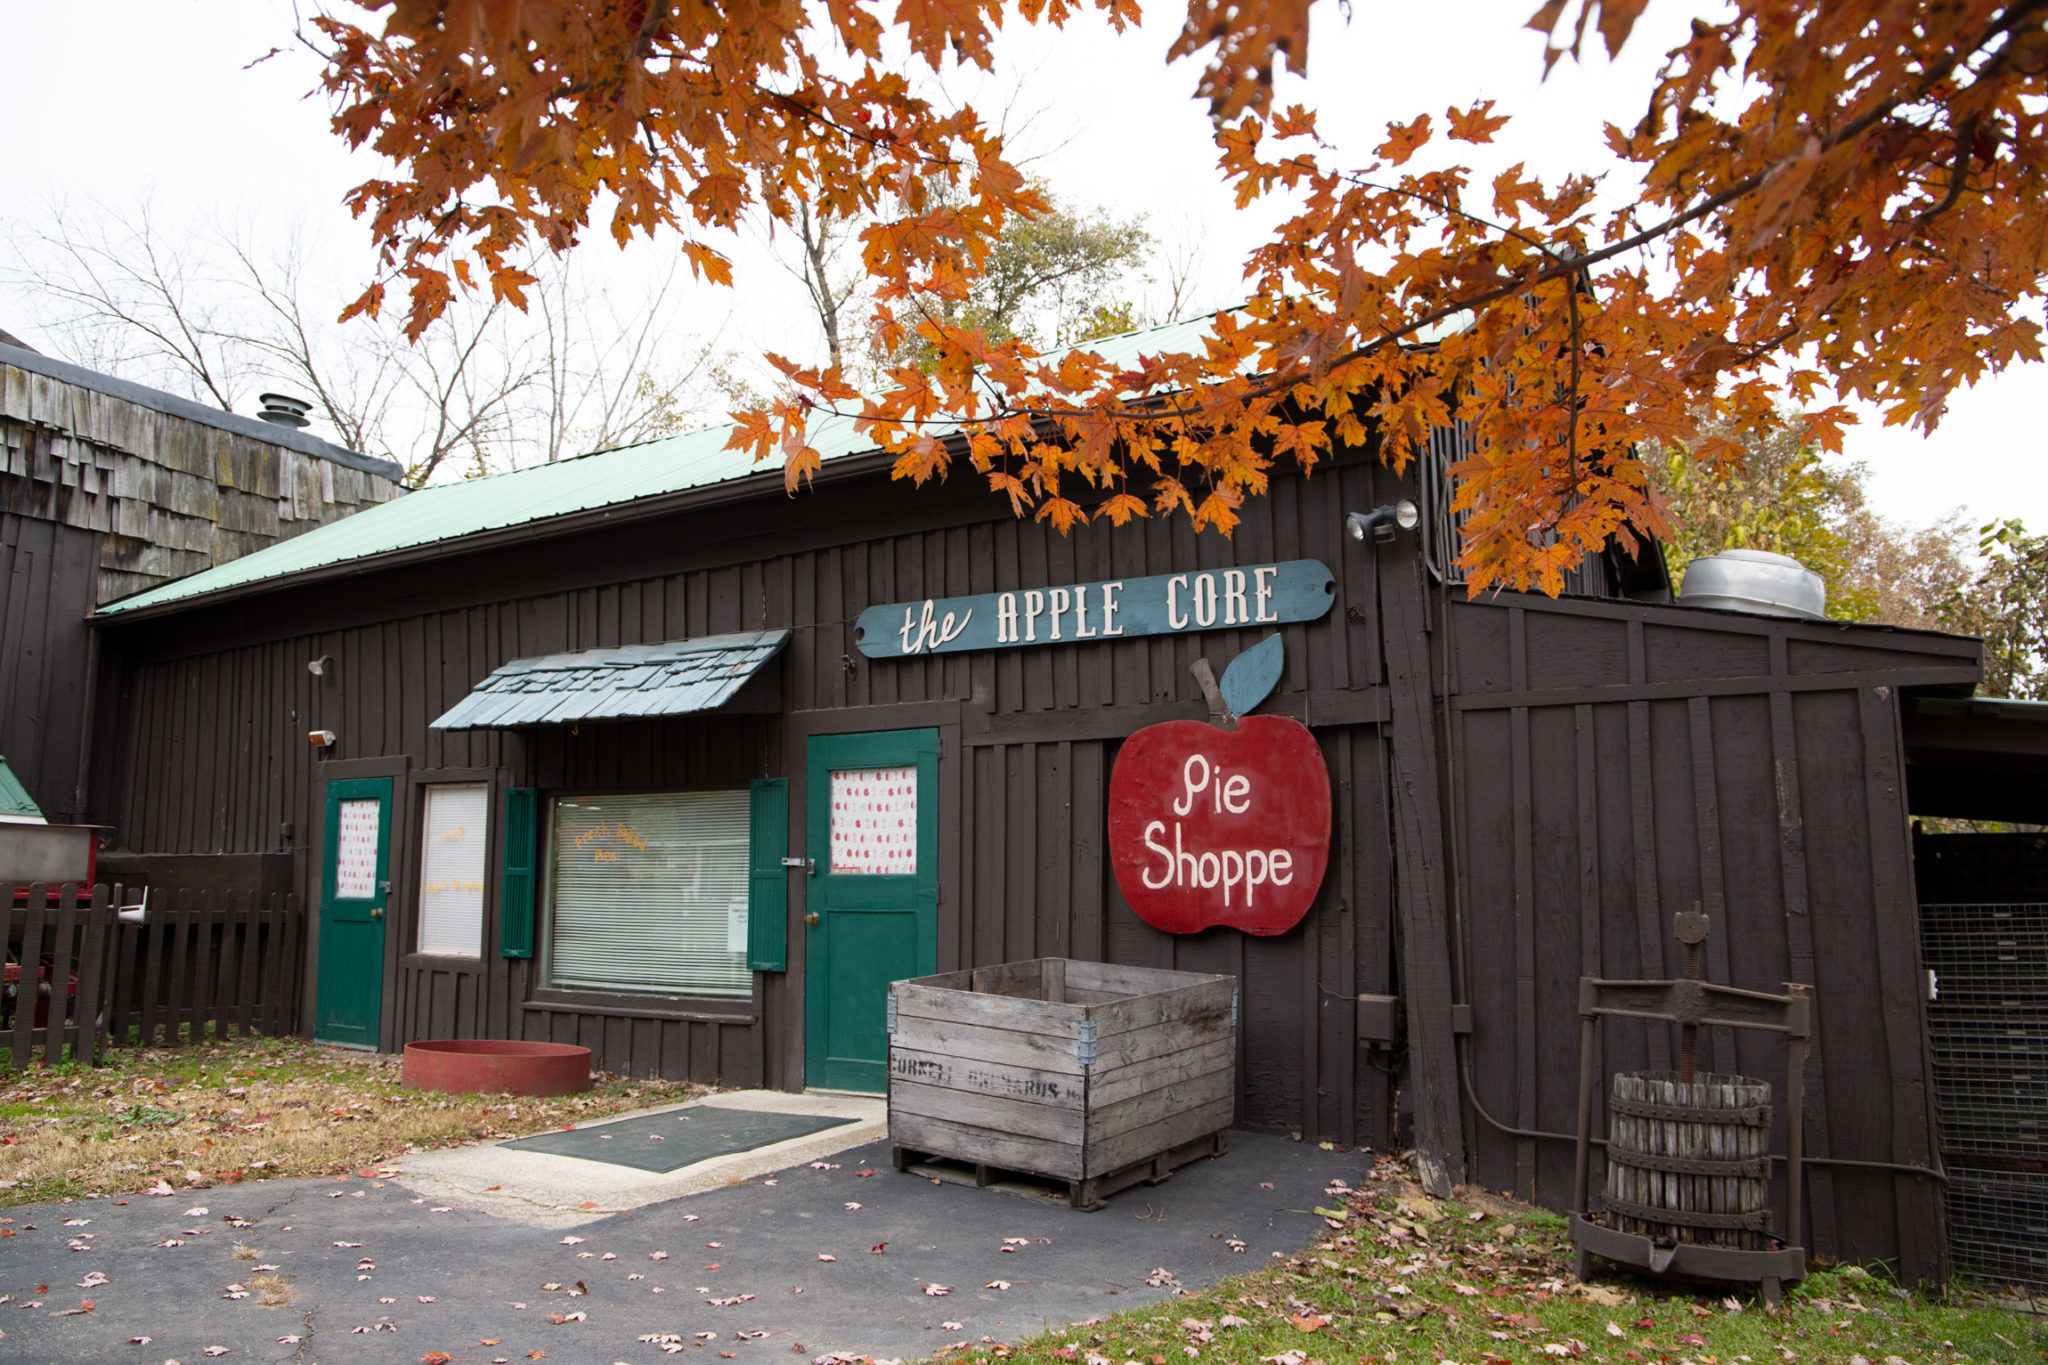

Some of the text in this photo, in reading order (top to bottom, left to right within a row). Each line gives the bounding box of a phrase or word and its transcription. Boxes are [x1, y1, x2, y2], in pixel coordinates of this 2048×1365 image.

[899, 566, 1279, 654] the APPLE CORE
[1173, 754, 1250, 816] Pie
[1142, 820, 1293, 907] Shoppe
